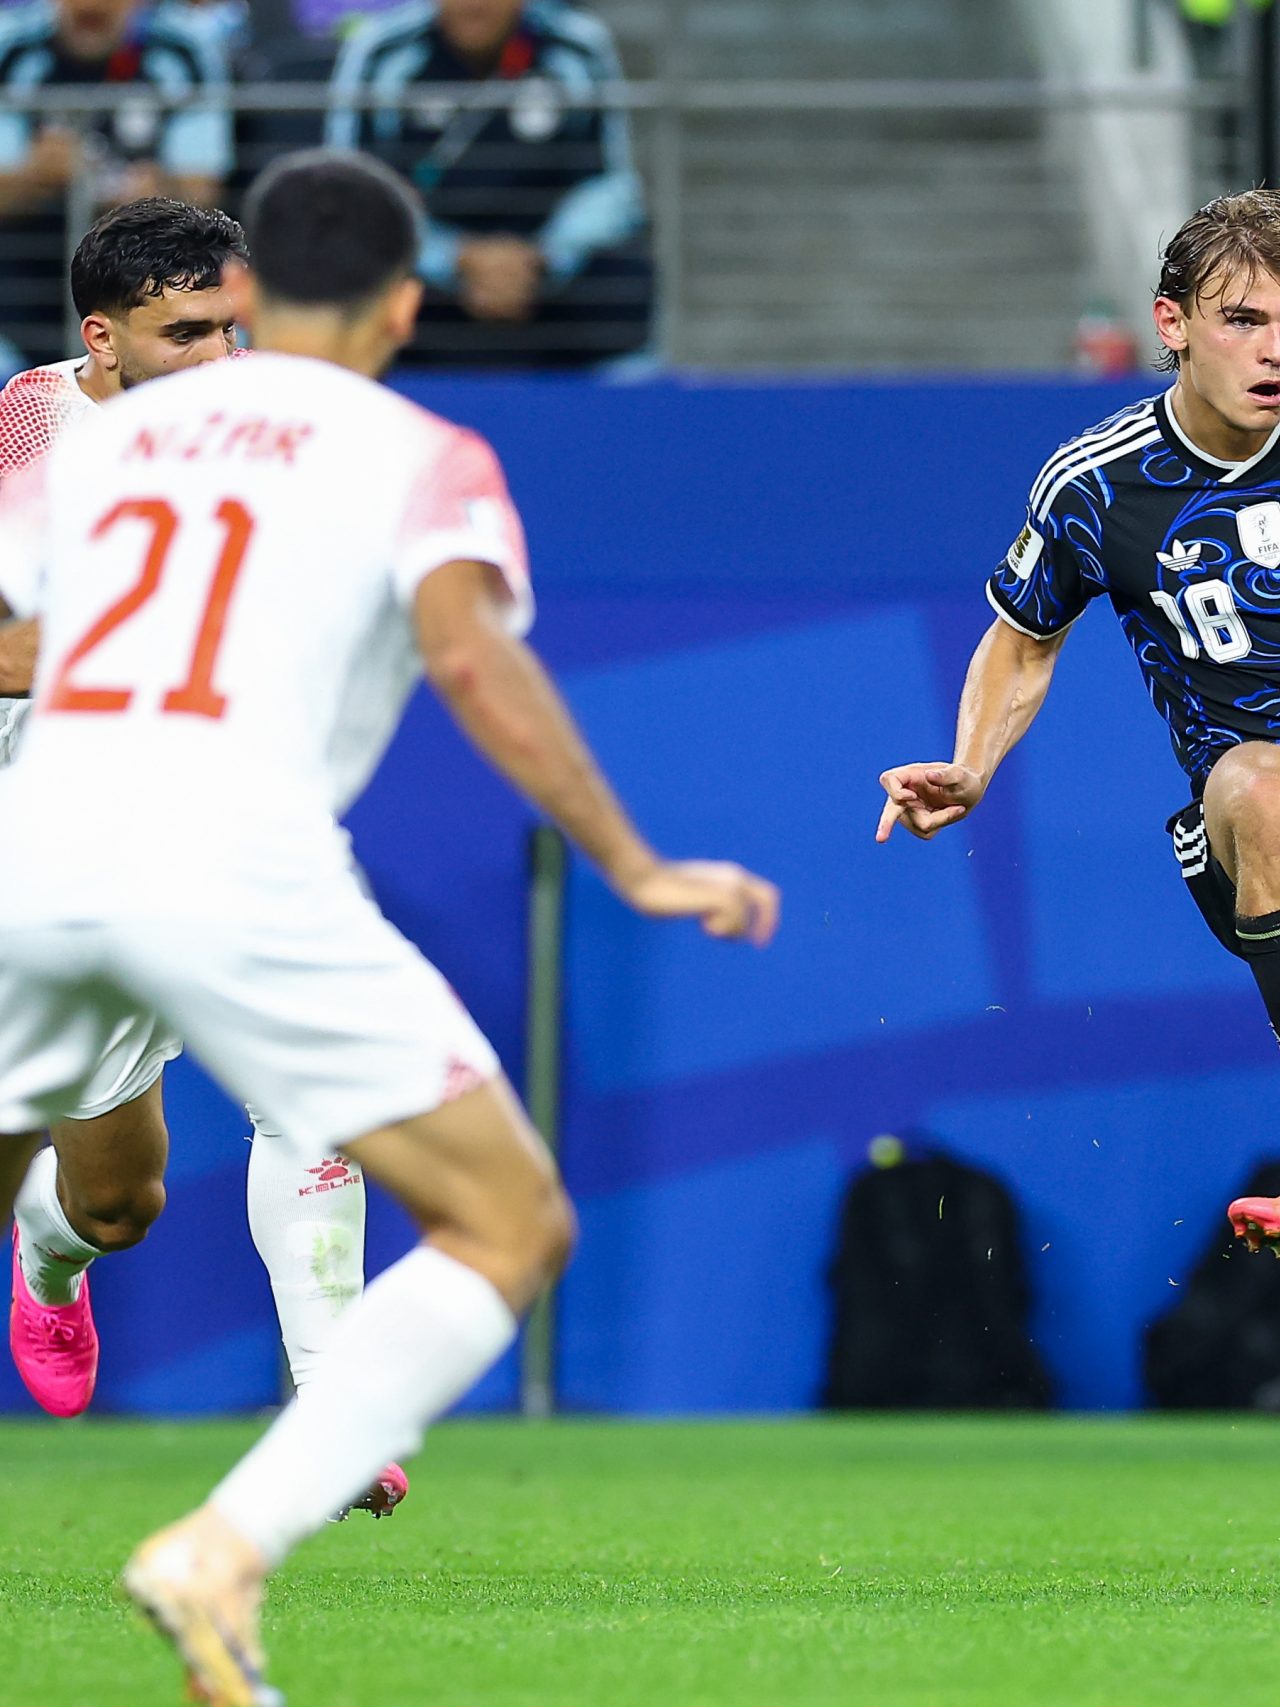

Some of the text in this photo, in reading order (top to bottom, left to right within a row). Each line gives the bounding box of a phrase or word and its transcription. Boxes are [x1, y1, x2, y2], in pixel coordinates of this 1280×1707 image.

[122, 409, 314, 468] NIZAR
[1258, 543, 1279, 554] FIFA
[42, 497, 257, 720] 21
[1149, 579, 1253, 664] 18
[298, 1174, 361, 1197] KELME
